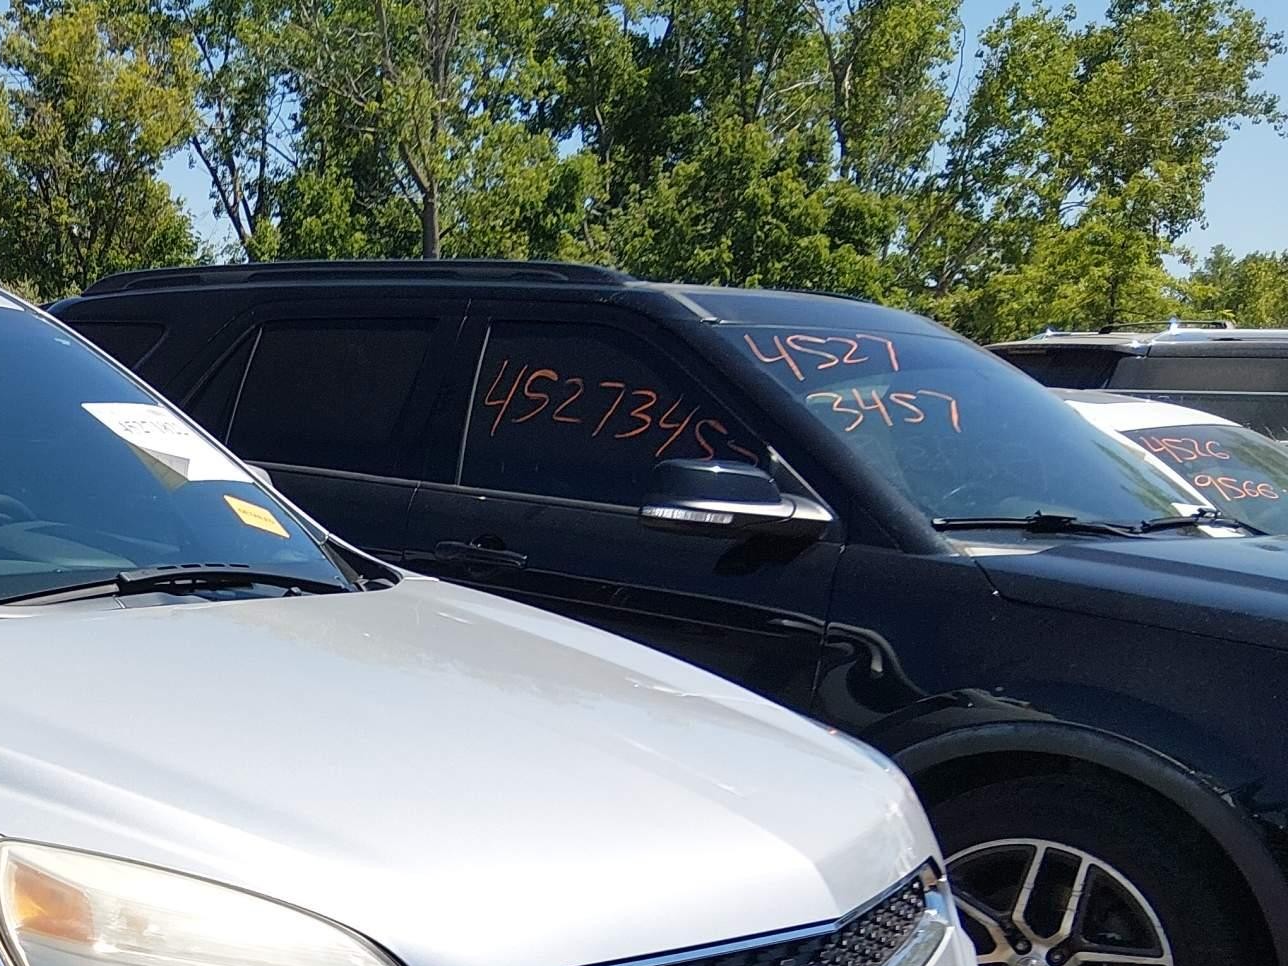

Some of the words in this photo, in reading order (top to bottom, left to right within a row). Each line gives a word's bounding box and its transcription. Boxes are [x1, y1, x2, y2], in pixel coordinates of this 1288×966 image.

[744, 333, 900, 381] 4527
[805, 386, 961, 433] 3457
[1138, 436, 1230, 464] 4526
[1194, 473, 1279, 502] 9566
